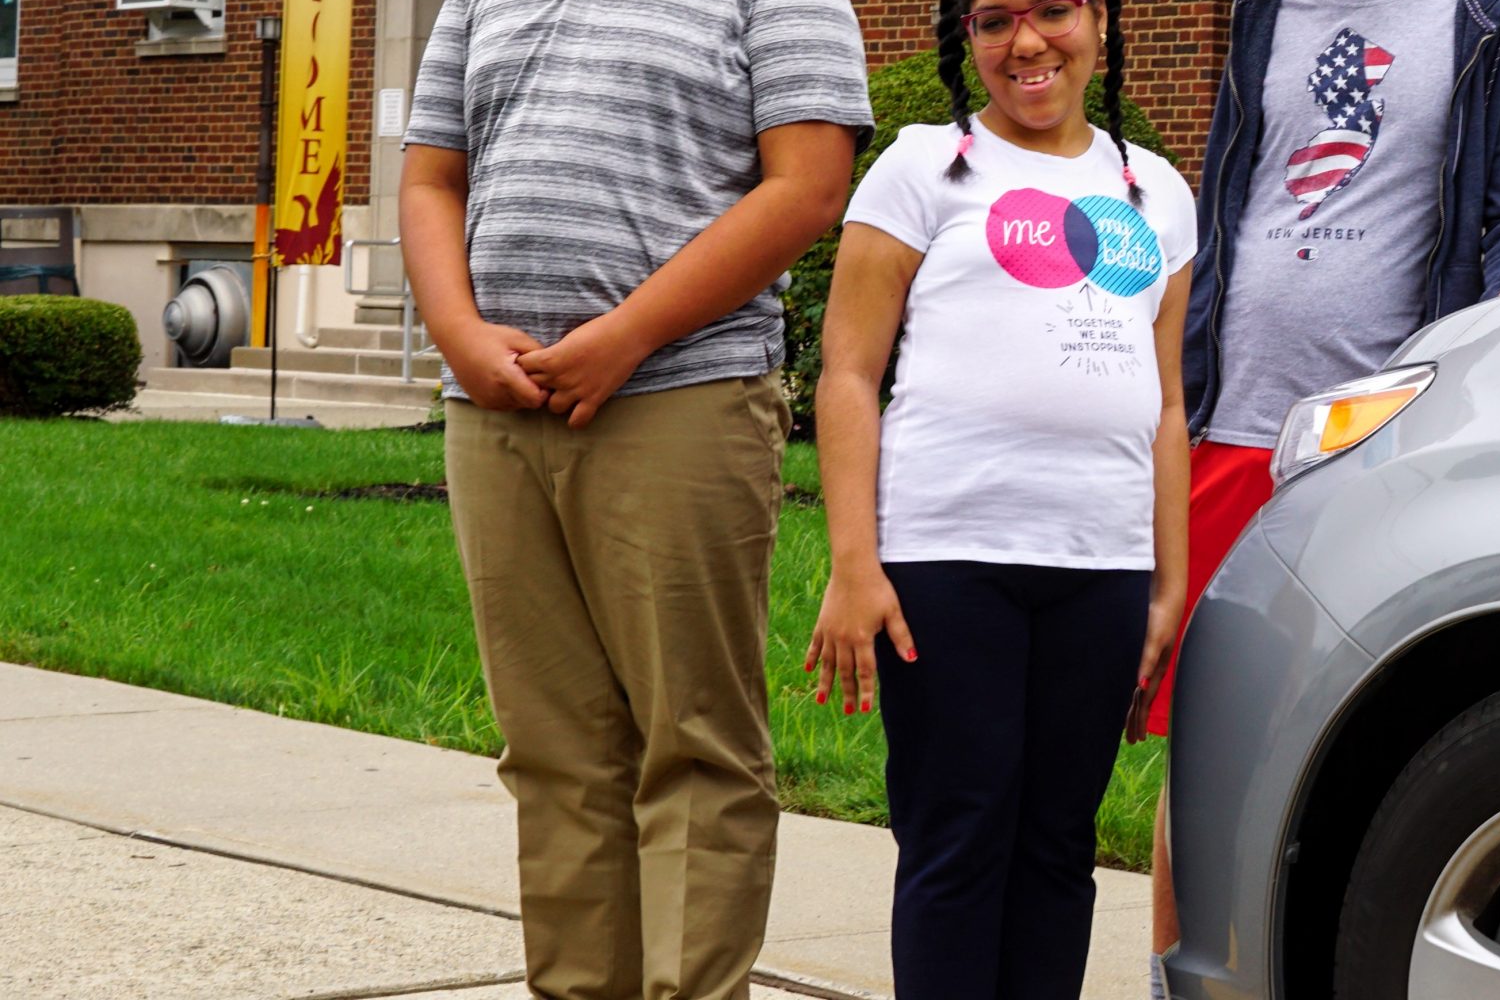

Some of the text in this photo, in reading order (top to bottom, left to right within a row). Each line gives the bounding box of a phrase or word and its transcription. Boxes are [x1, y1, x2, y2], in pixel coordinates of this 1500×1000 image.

[1003, 219, 1057, 247] me
[1265, 227, 1366, 241] NEW JERSEY
[1067, 318, 1123, 328] TOGETHER
[1079, 330, 1119, 341] WE ARE
